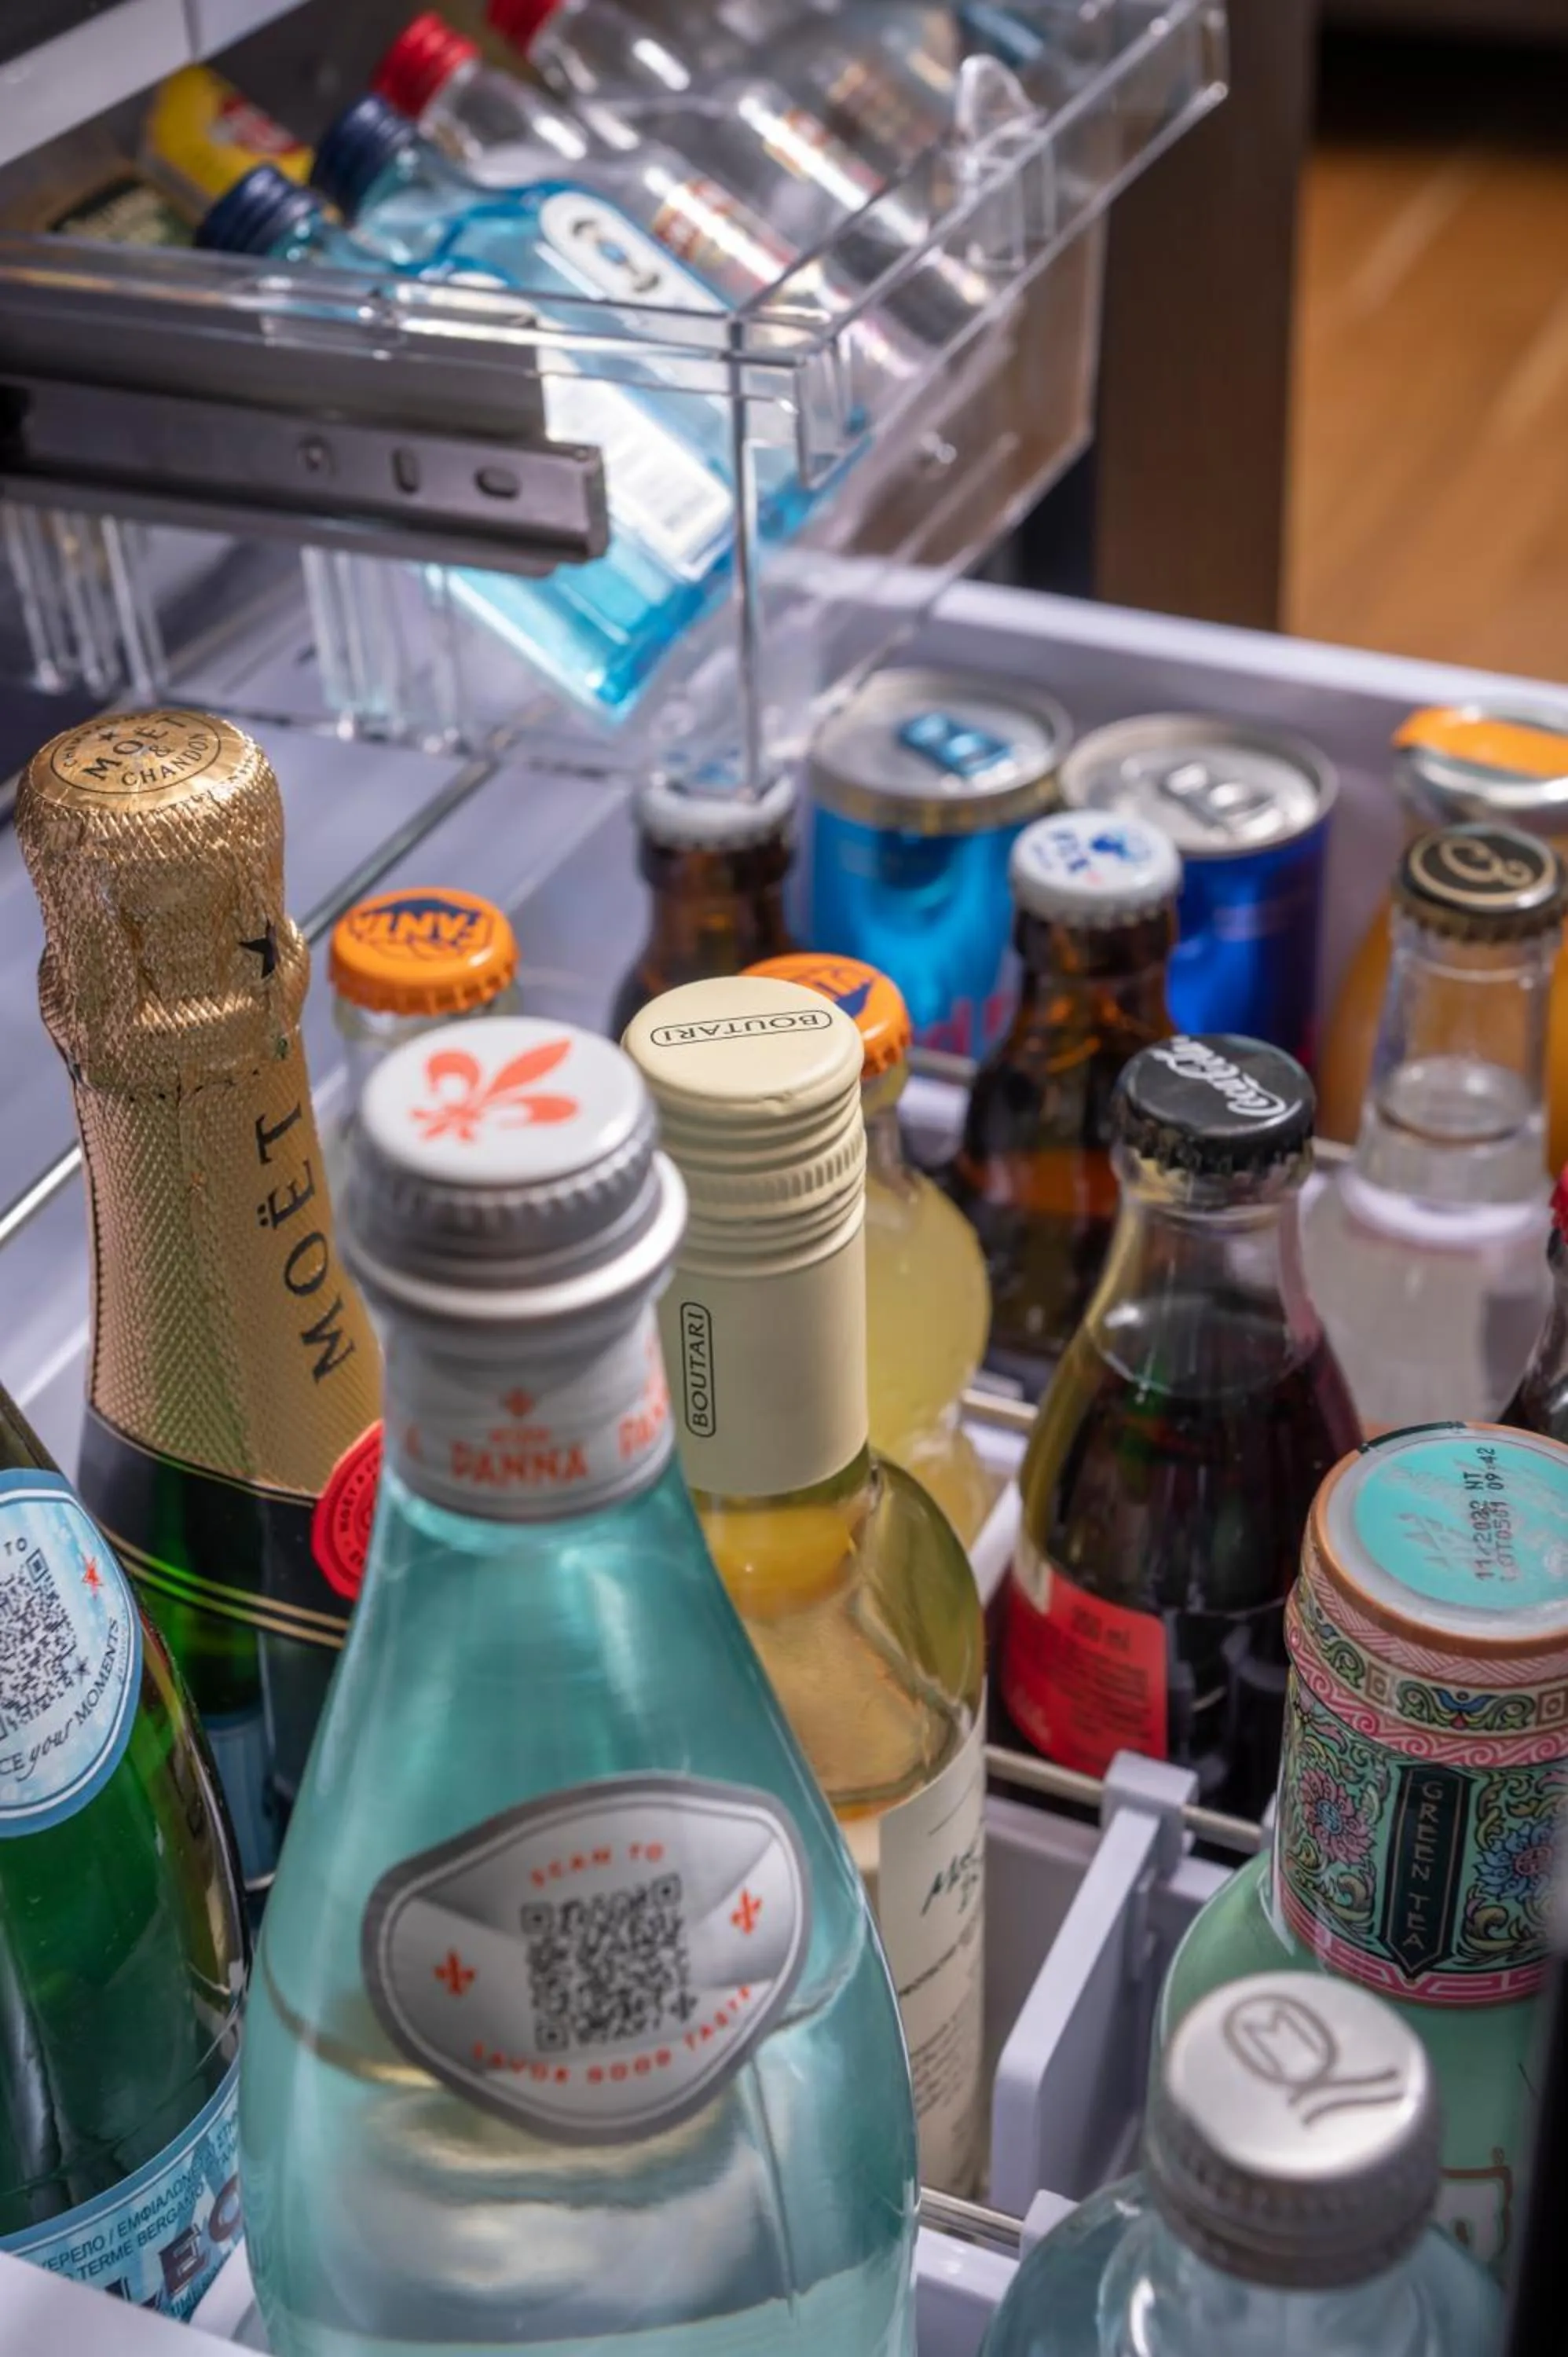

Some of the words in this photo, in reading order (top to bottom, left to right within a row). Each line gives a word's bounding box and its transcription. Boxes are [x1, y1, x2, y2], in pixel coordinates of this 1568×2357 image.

[120, 732, 209, 786] CHANDON
[148, 742, 176, 758] &
[665, 1014, 819, 1043] BOUTARI
[255, 1101, 357, 1384] MOËT
[687, 1311, 709, 1428] BOUTARI
[1476, 1446, 1505, 1491] 09:42
[3, 1537, 28, 1556] TO
[16, 1717, 74, 1783] your
[75, 1615, 119, 1727] MOMENTS
[1411, 1780, 1444, 1882] GREEN
[1402, 1891, 1431, 1951] TEA
[76, 2242, 134, 2282] TERME
[137, 2179, 205, 2248] BERGAMO
